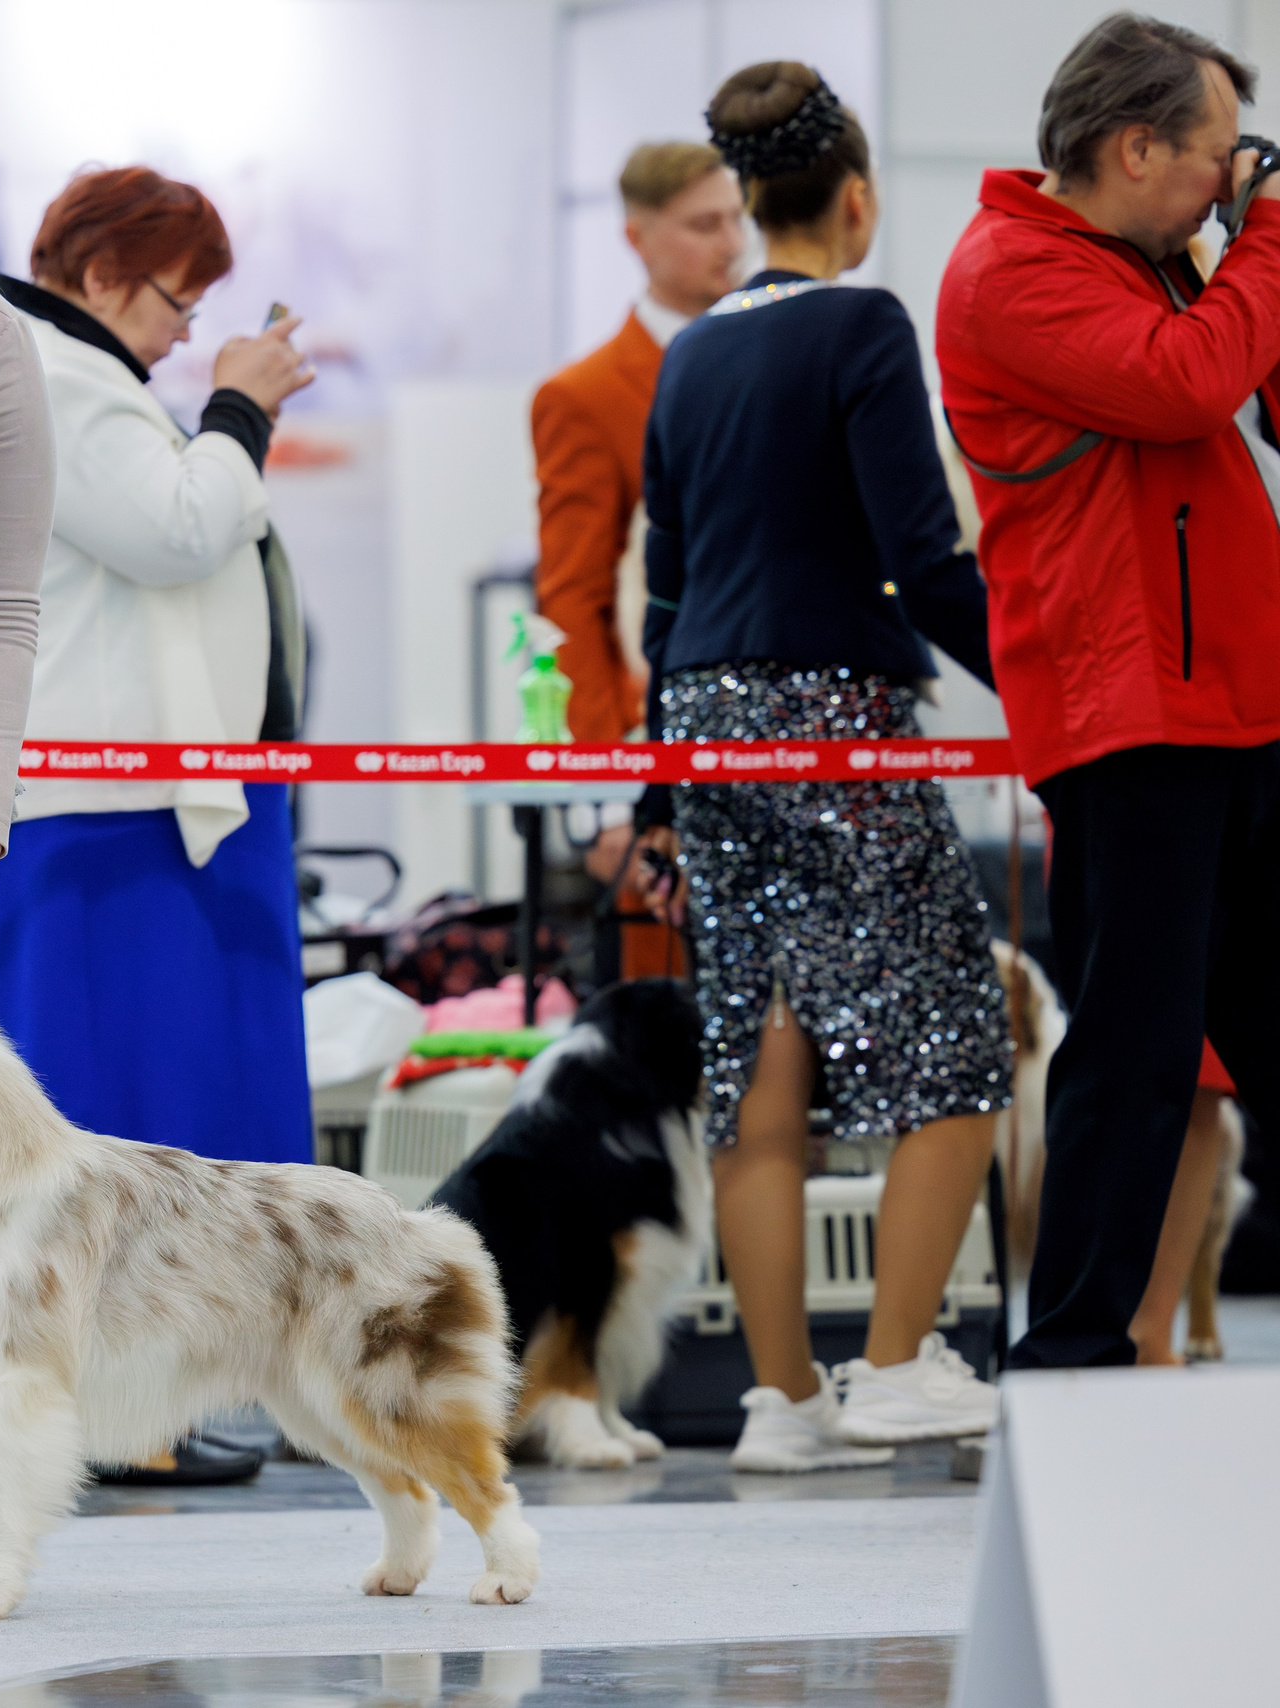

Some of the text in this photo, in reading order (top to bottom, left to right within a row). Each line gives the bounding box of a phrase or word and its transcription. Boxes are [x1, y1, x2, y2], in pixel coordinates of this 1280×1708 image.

[46, 748, 148, 773] Kazan Expo
[211, 749, 312, 774] Kazan Expo
[385, 751, 485, 776] Kazan Expo
[556, 749, 656, 774] Kazan Expo
[721, 748, 818, 772] Kazan Expo
[878, 747, 974, 771] Kazan Expo
